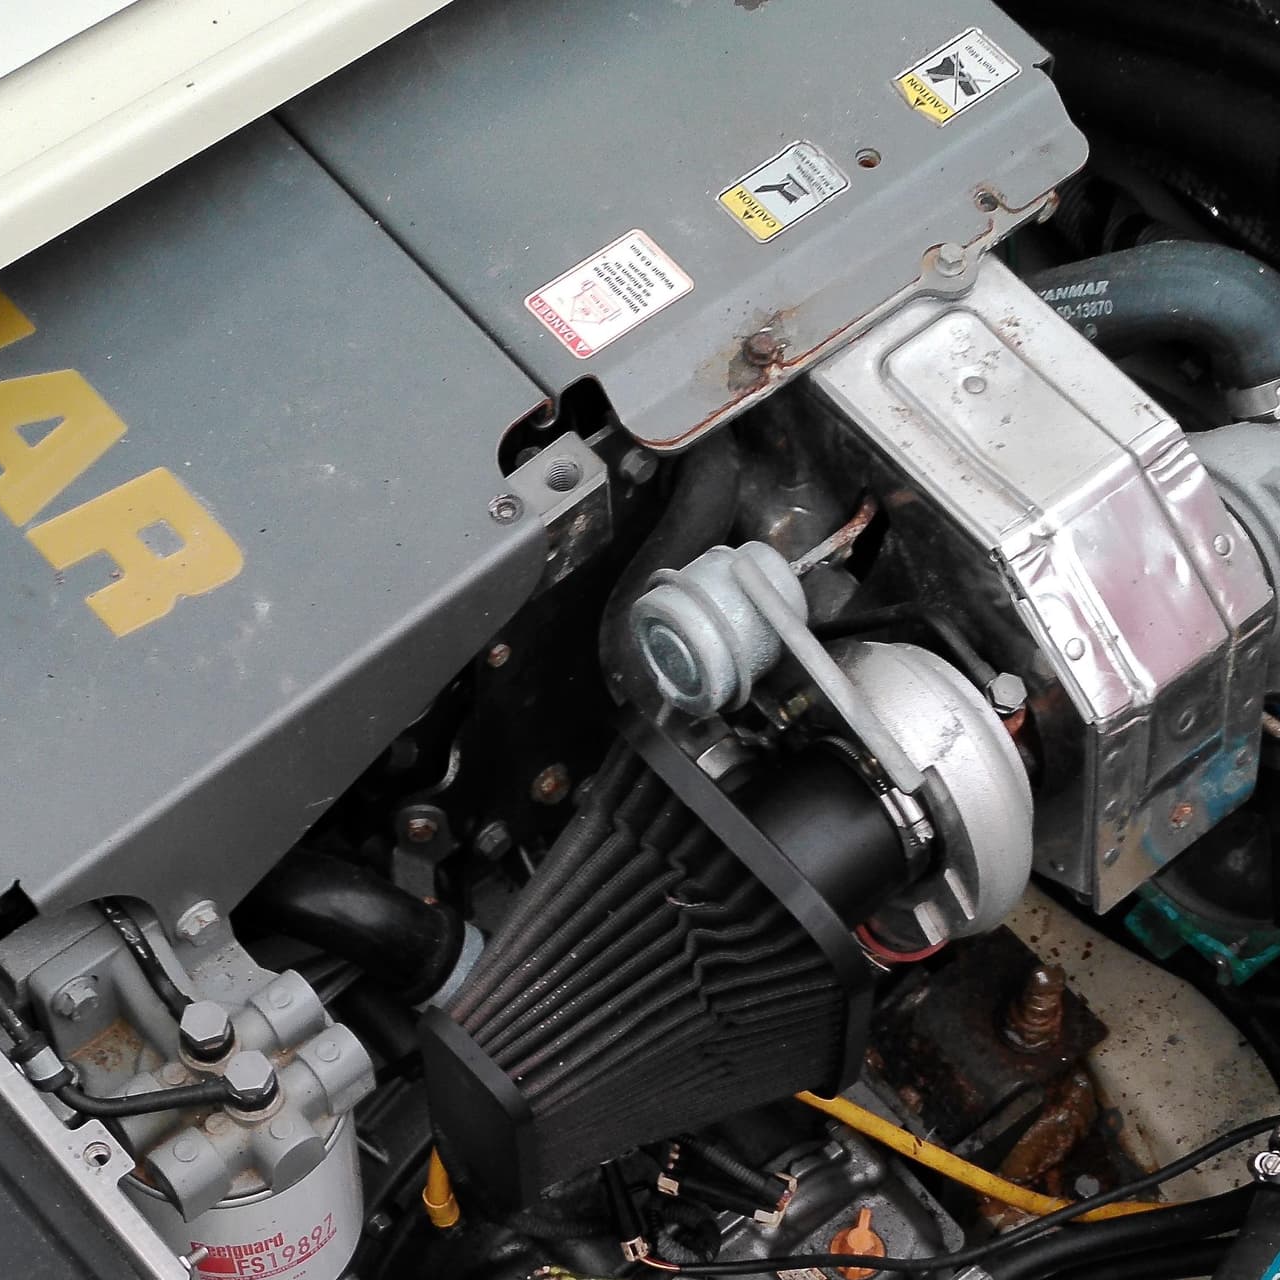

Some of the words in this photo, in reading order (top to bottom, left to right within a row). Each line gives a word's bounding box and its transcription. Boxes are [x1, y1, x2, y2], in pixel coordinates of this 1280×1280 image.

[905, 77, 949, 115] CAUTION
[734, 190, 777, 228] CAUTION
[630, 244, 642, 256] ton
[593, 266, 604, 278] the
[602, 262, 617, 275] only
[603, 277, 623, 296] lifting
[622, 294, 640, 313] When
[530, 296, 577, 341] DANGER
